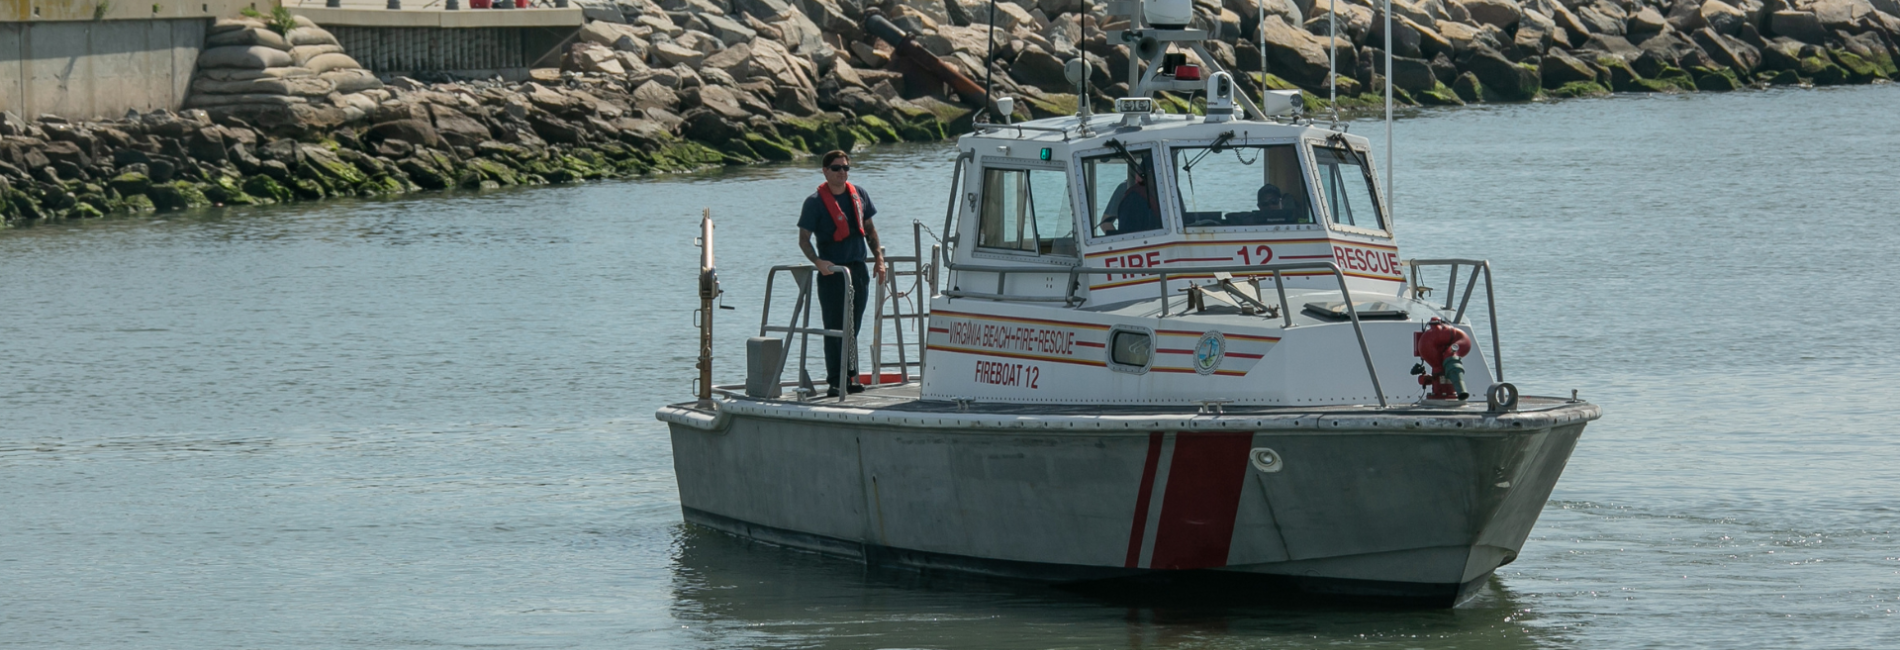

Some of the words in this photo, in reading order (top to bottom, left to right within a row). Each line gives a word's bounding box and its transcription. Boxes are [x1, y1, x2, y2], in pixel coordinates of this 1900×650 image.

[1105, 251, 1160, 281] FIRE
[1238, 245, 1273, 266] 12
[1333, 246, 1402, 275] RESCUE
[949, 321, 981, 347] VIRGINIA
[975, 360, 1023, 387] FIREBOAT
[1025, 365, 1040, 389] 12
